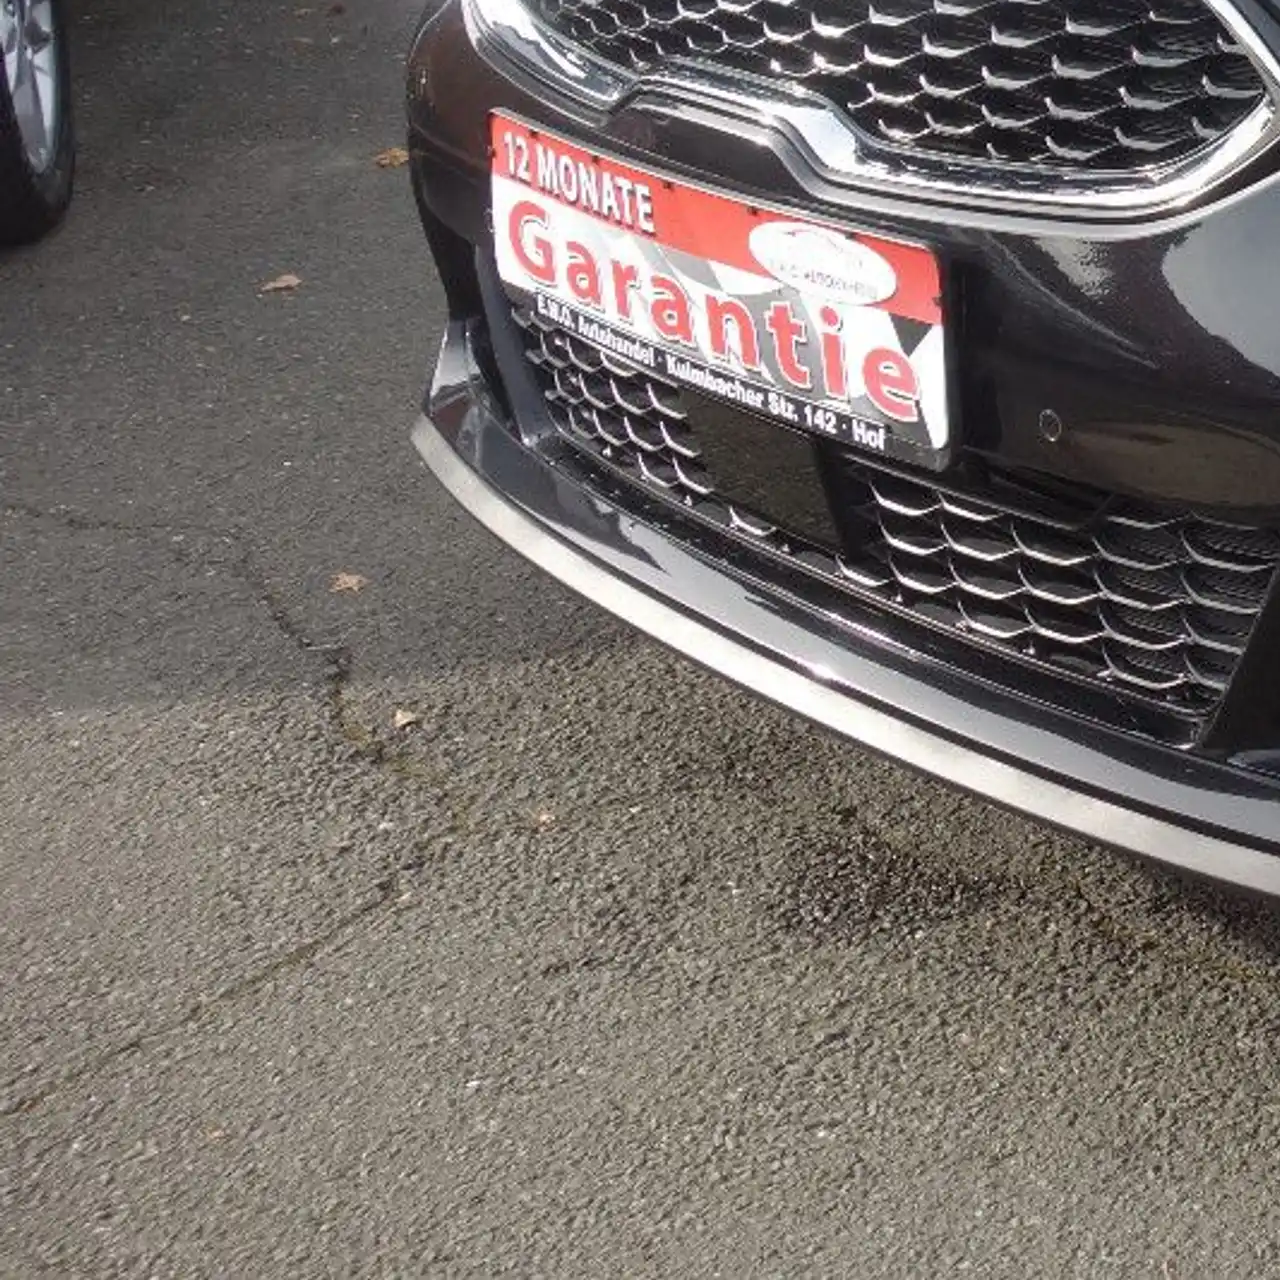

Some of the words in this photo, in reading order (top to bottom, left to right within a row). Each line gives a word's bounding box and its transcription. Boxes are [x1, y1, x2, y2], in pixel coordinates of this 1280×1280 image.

[503, 131, 531, 181] 12
[535, 143, 657, 234] MONATE
[508, 199, 921, 423] Garantie
[666, 353, 764, 410] Kulmbacher
[767, 387, 799, 423] Str.
[804, 403, 837, 435] 142
[851, 418, 887, 452] Hof
